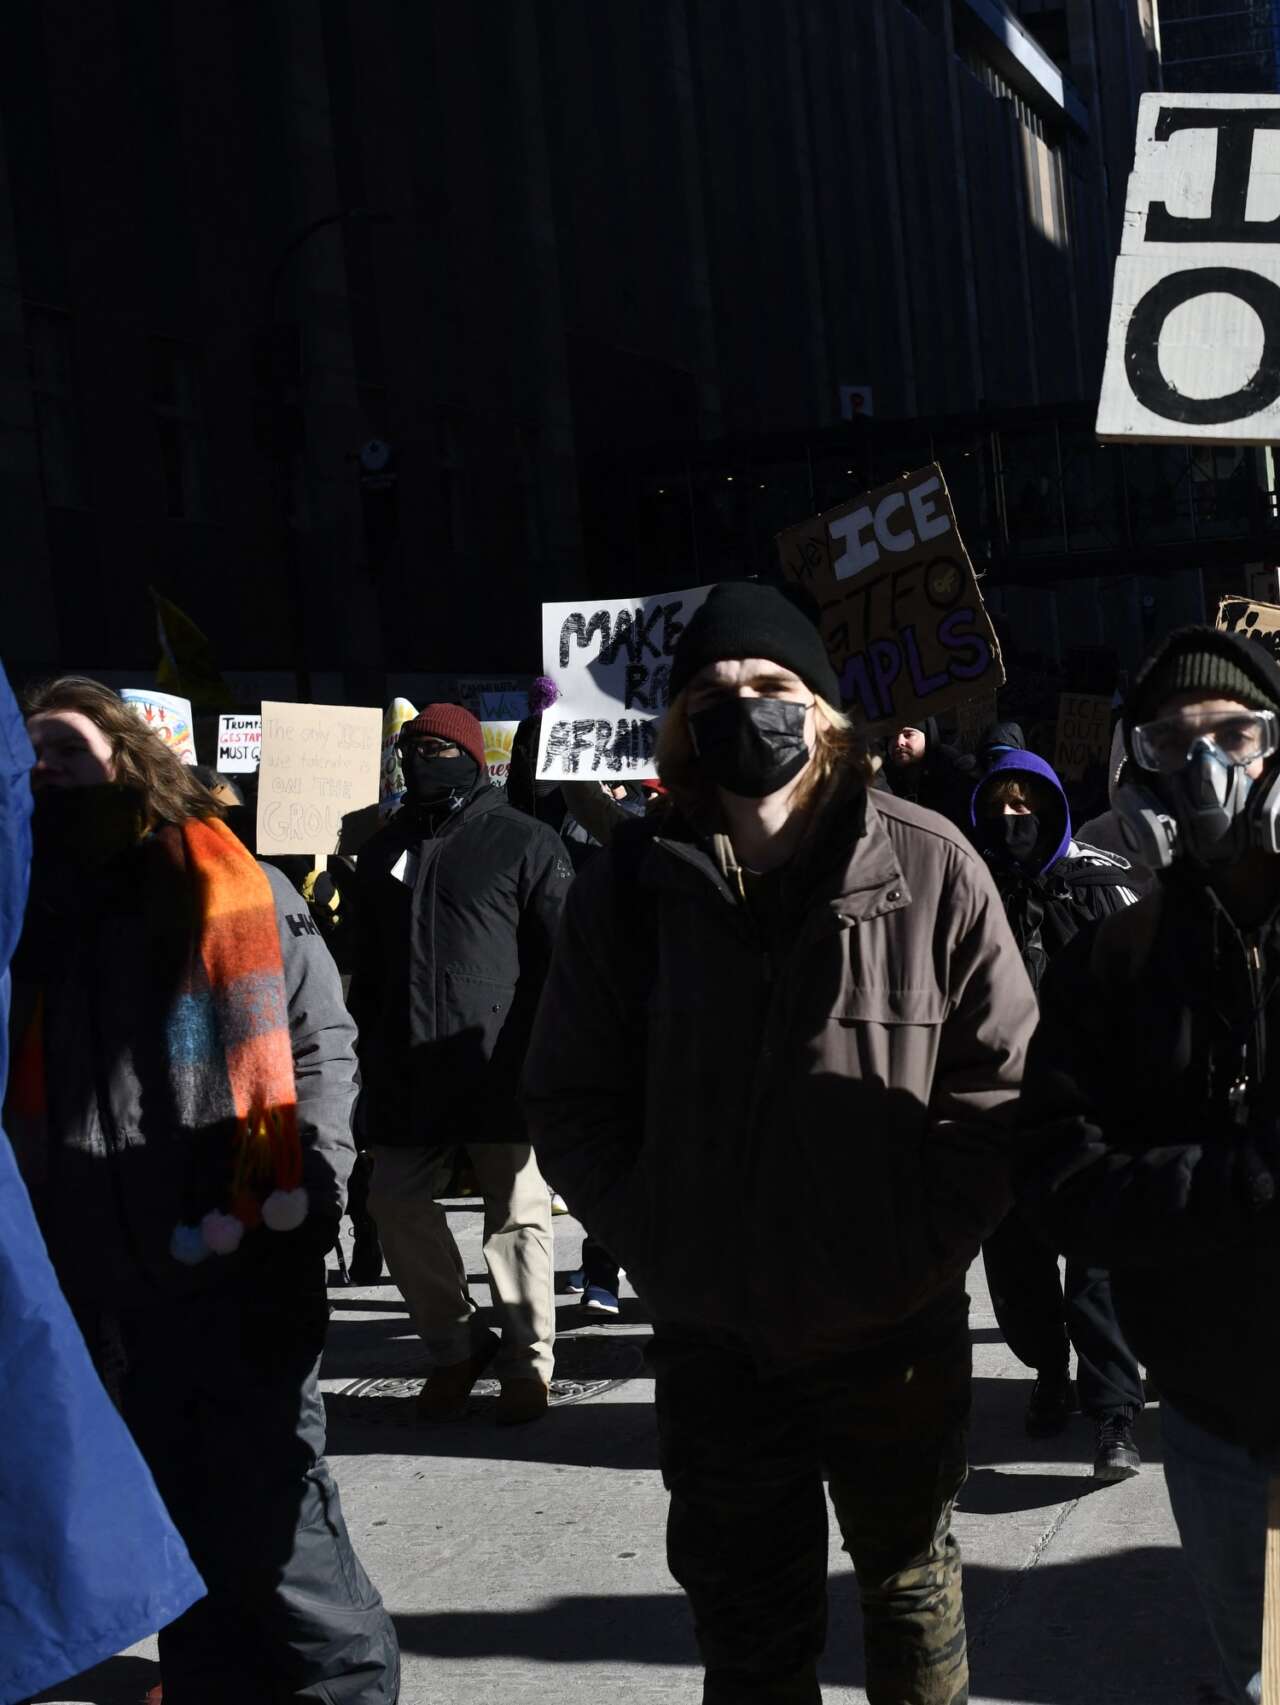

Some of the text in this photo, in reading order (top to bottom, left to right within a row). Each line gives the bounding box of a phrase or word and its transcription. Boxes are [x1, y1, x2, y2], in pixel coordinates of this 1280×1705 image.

[828, 475, 952, 581] ICE
[559, 600, 684, 669] MAKE
[220, 732, 262, 743] GESTAP
[267, 719, 295, 740] The
[220, 746, 248, 760] MUST
[271, 776, 302, 794] ON
